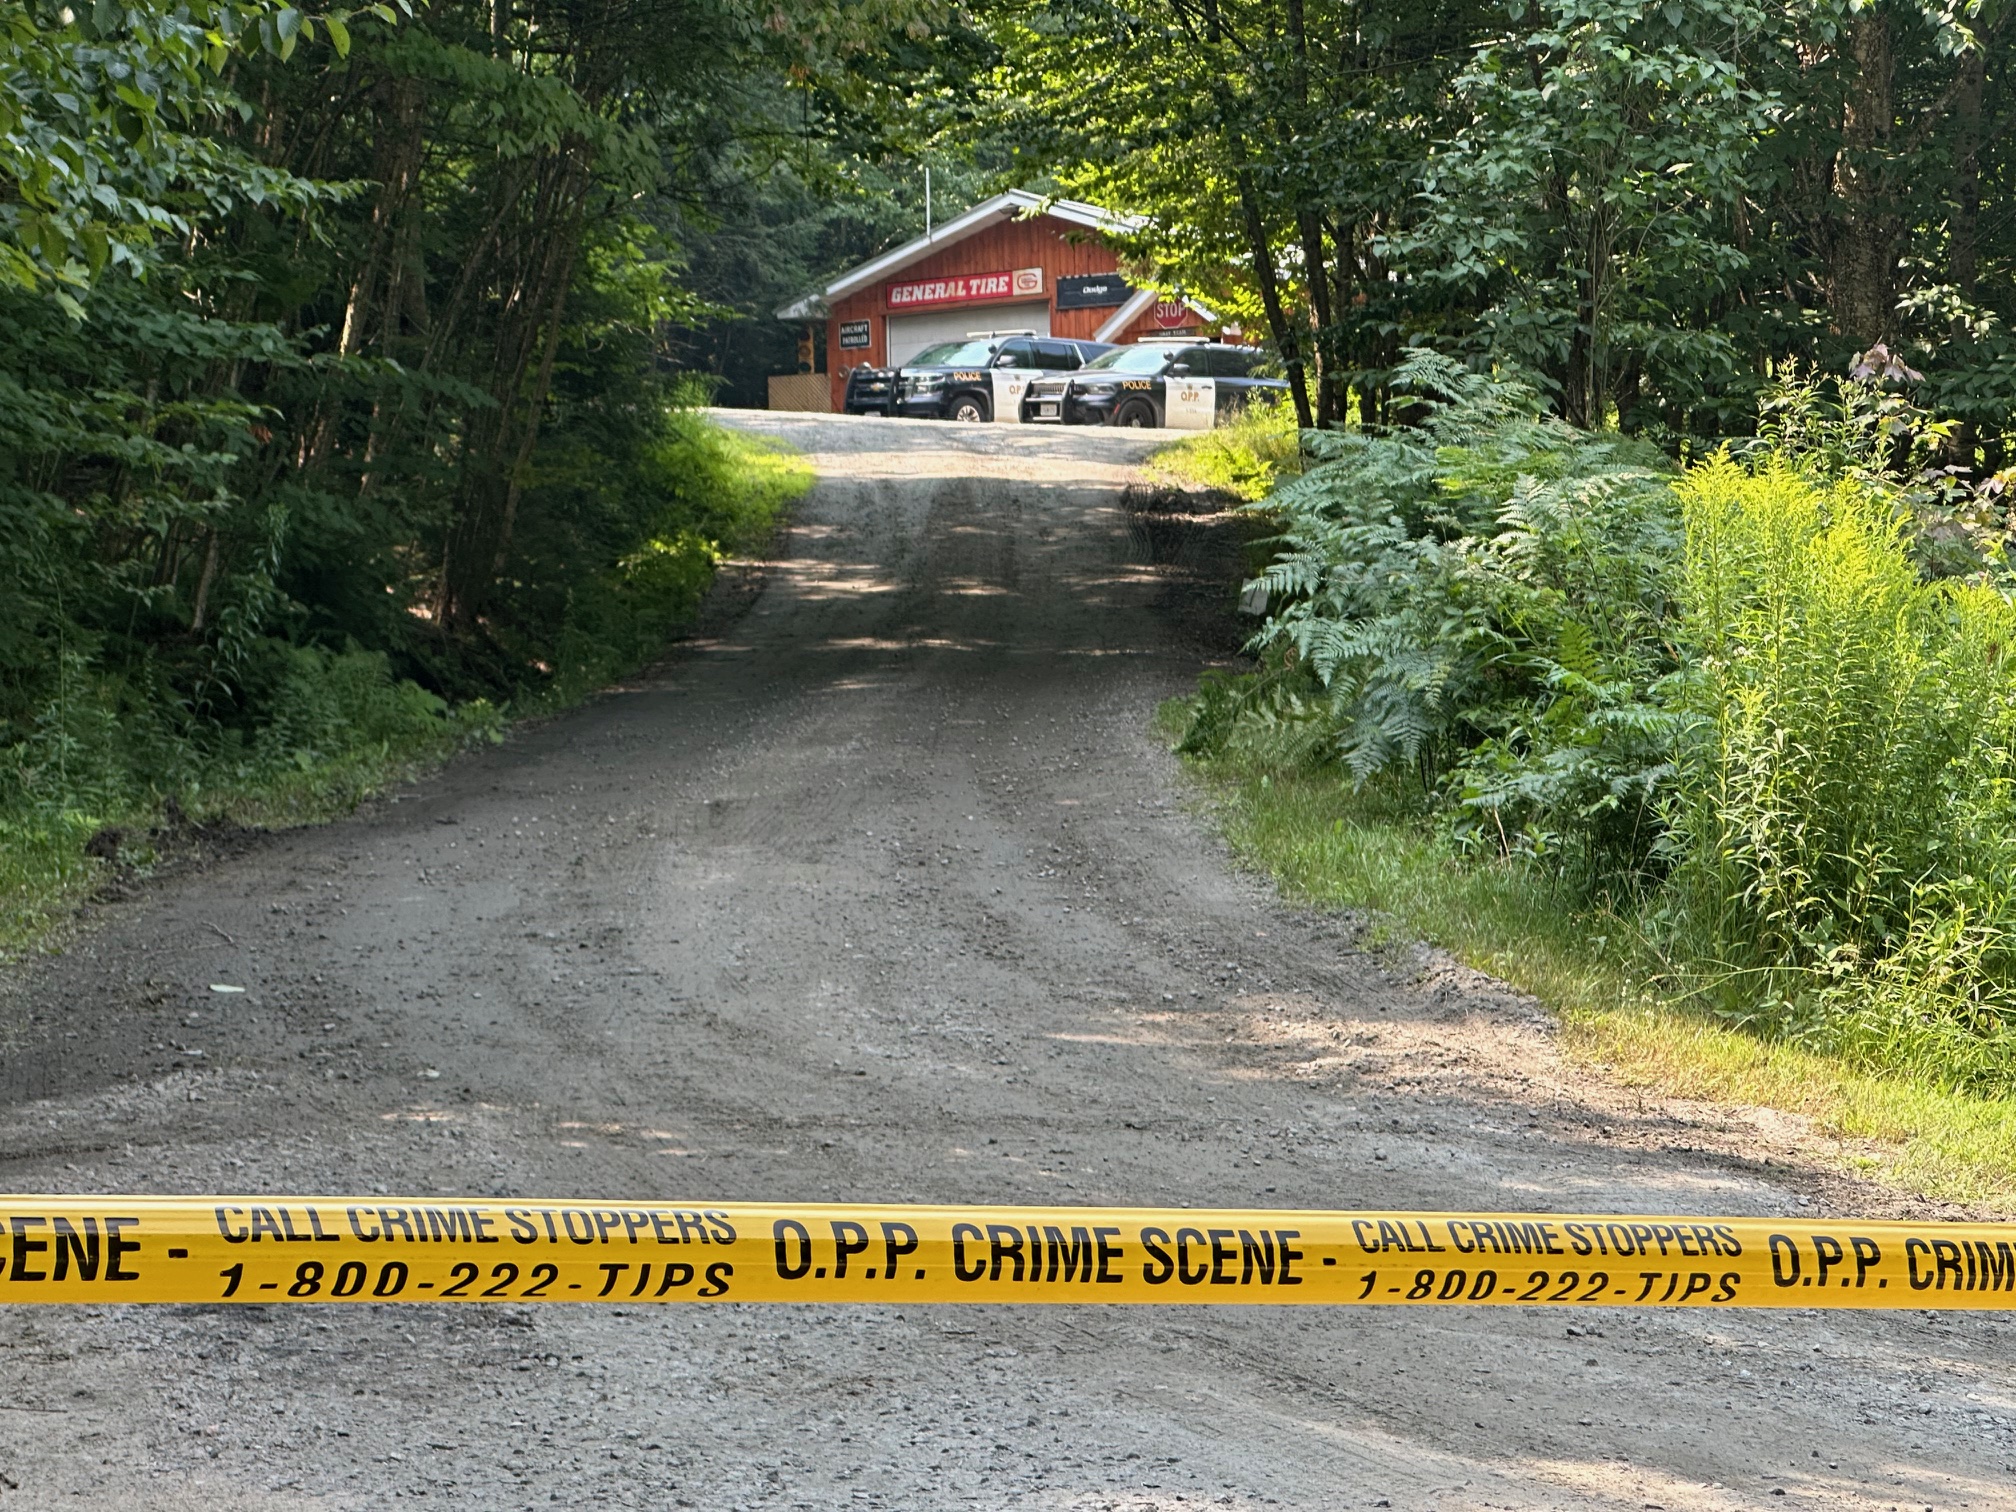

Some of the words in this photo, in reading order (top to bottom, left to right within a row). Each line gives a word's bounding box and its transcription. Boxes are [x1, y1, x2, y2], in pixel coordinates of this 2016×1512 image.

[891, 281, 966, 303] GENERAL
[970, 276, 1010, 296] TIRE
[1082, 285, 1108, 295] Dodge
[1156, 303, 1186, 318] STOP
[841, 323, 868, 334] AIRCRAFT
[842, 335, 868, 345] PATROLLED
[953, 371, 982, 381] POLICE
[1122, 380, 1152, 390] POLICE
[215, 1206, 339, 1243] CALL
[346, 1206, 499, 1244] CRIME
[506, 1207, 737, 1245] STOPPERS
[1351, 1219, 1445, 1253] CALL
[1446, 1220, 1564, 1255] CRIME
[1564, 1222, 1742, 1257] STOPPERS
[0, 1217, 141, 1282] ENE
[773, 1219, 926, 1280] O.P.P.
[952, 1223, 1124, 1283] CRIME
[1140, 1227, 1303, 1285] SCENE
[1769, 1234, 1888, 1288] O.P.P.
[1905, 1238, 2016, 1292] CRIM
[220, 1261, 734, 1298] 1-800-222-TIPS
[1358, 1269, 1740, 1302] 1-800-222-TIPS
